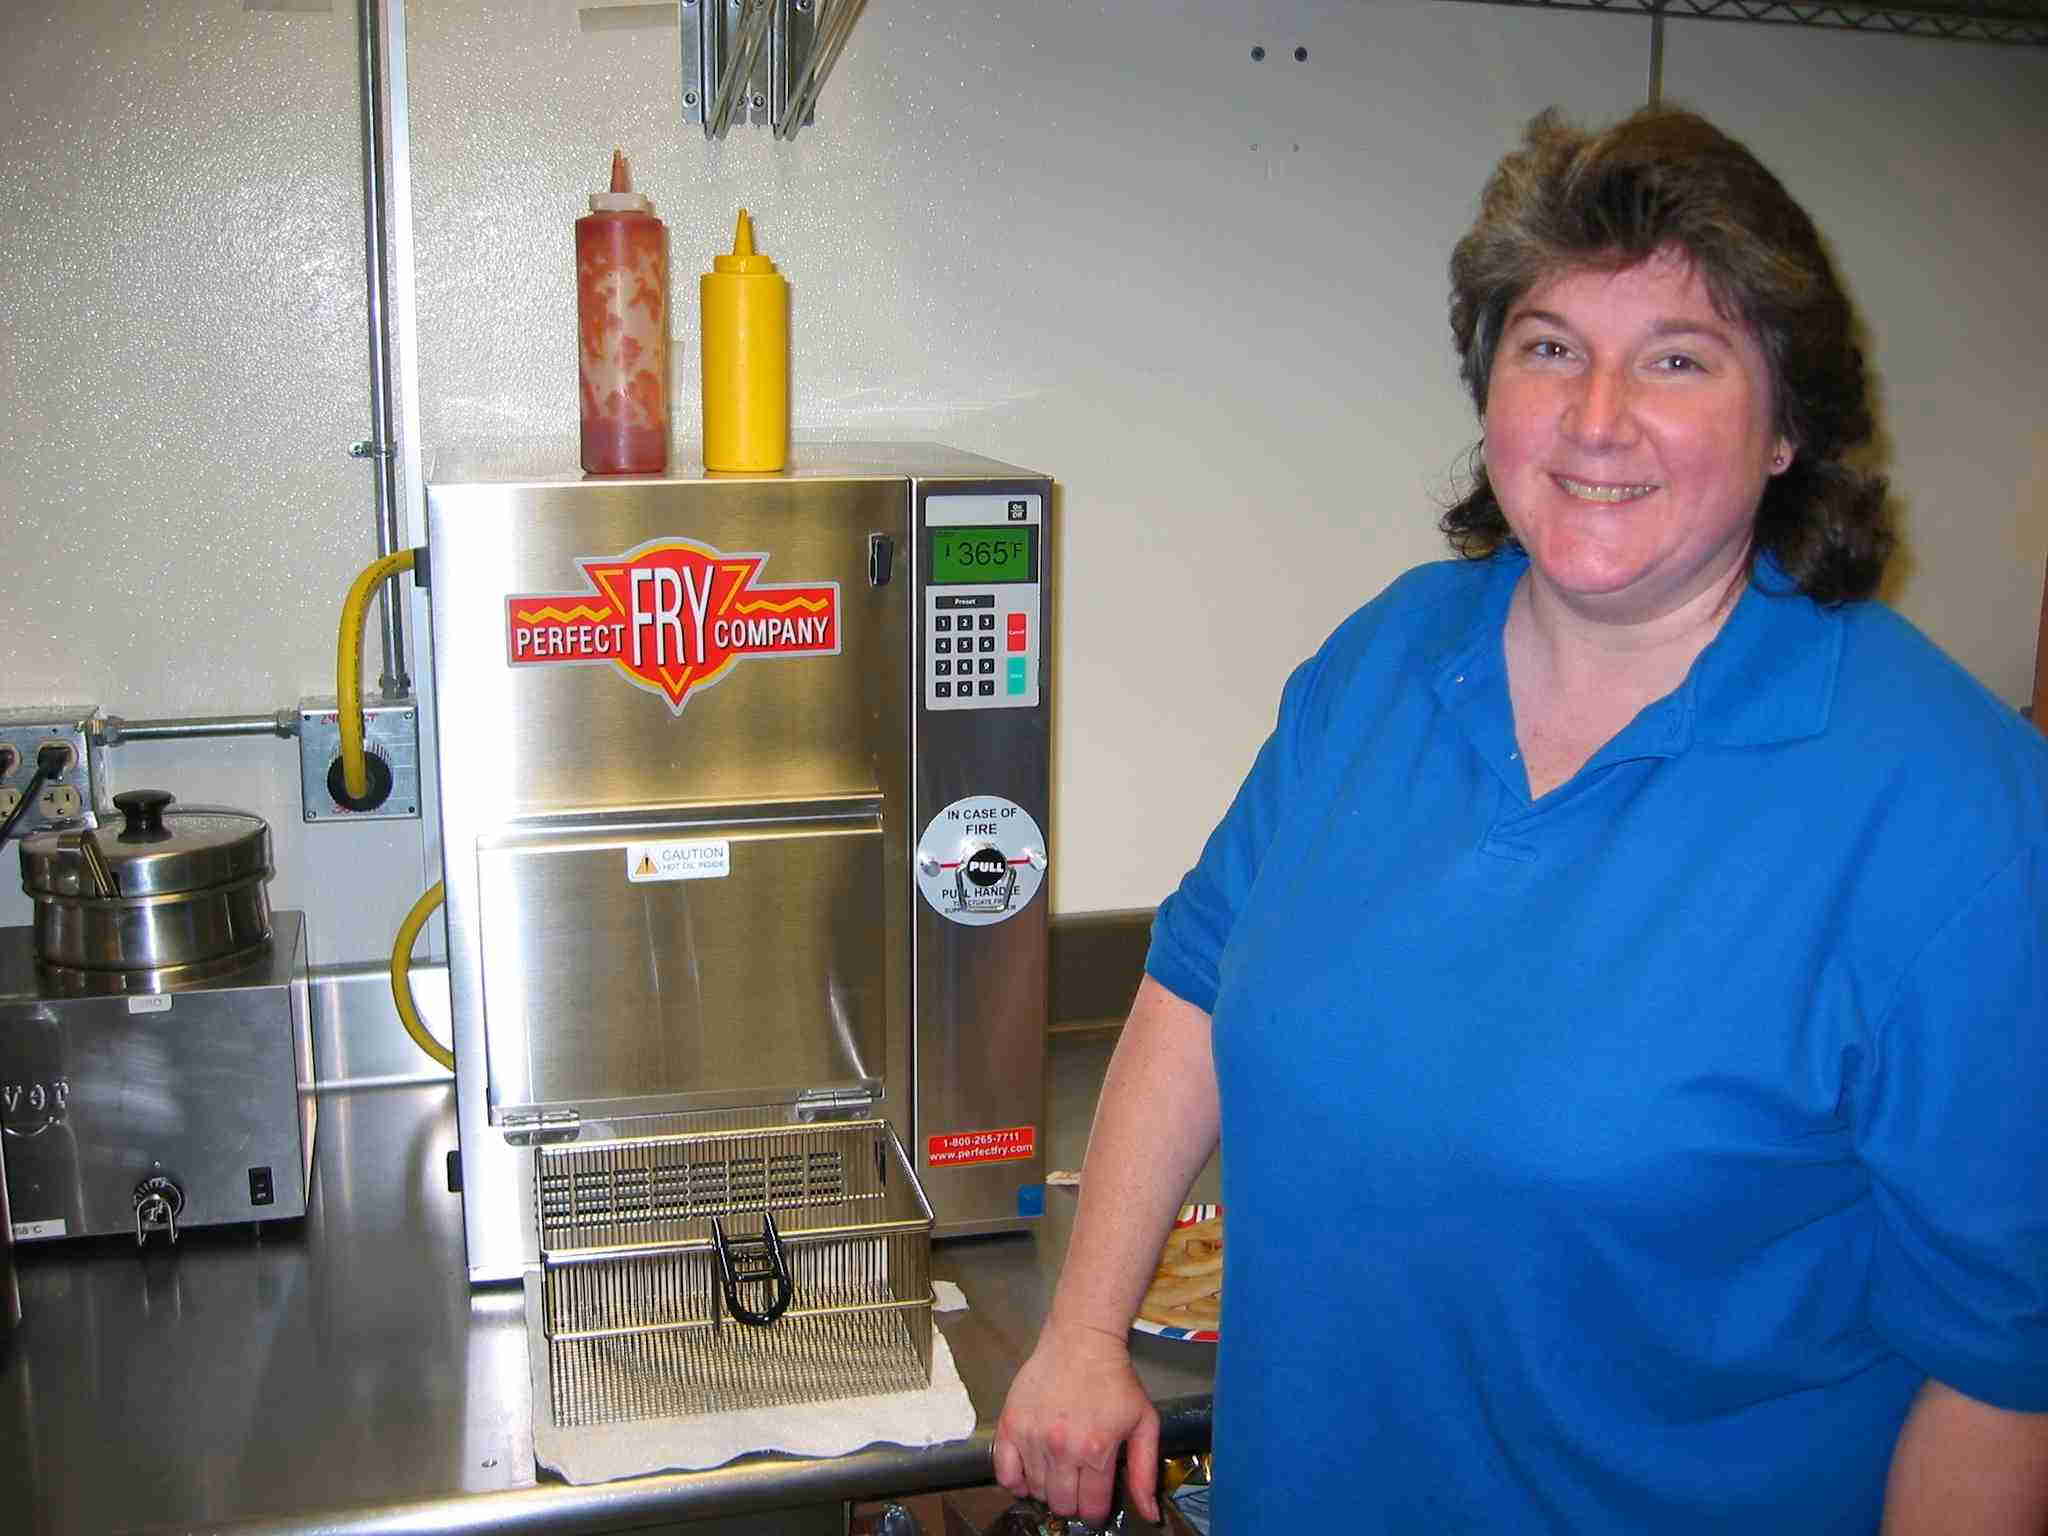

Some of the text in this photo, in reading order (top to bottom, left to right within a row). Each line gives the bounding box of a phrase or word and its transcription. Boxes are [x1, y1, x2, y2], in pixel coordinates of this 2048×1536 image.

[516, 564, 829, 667] PERFECT FRY COMPANY
[947, 807, 1017, 820] IN CASE OF
[966, 823, 997, 835] FIRE
[662, 847, 724, 863] CAUTION
[969, 861, 1004, 872] PULL
[942, 887, 969, 899] PUL
[929, 1144, 1033, 1161] www.perfectfry.com
